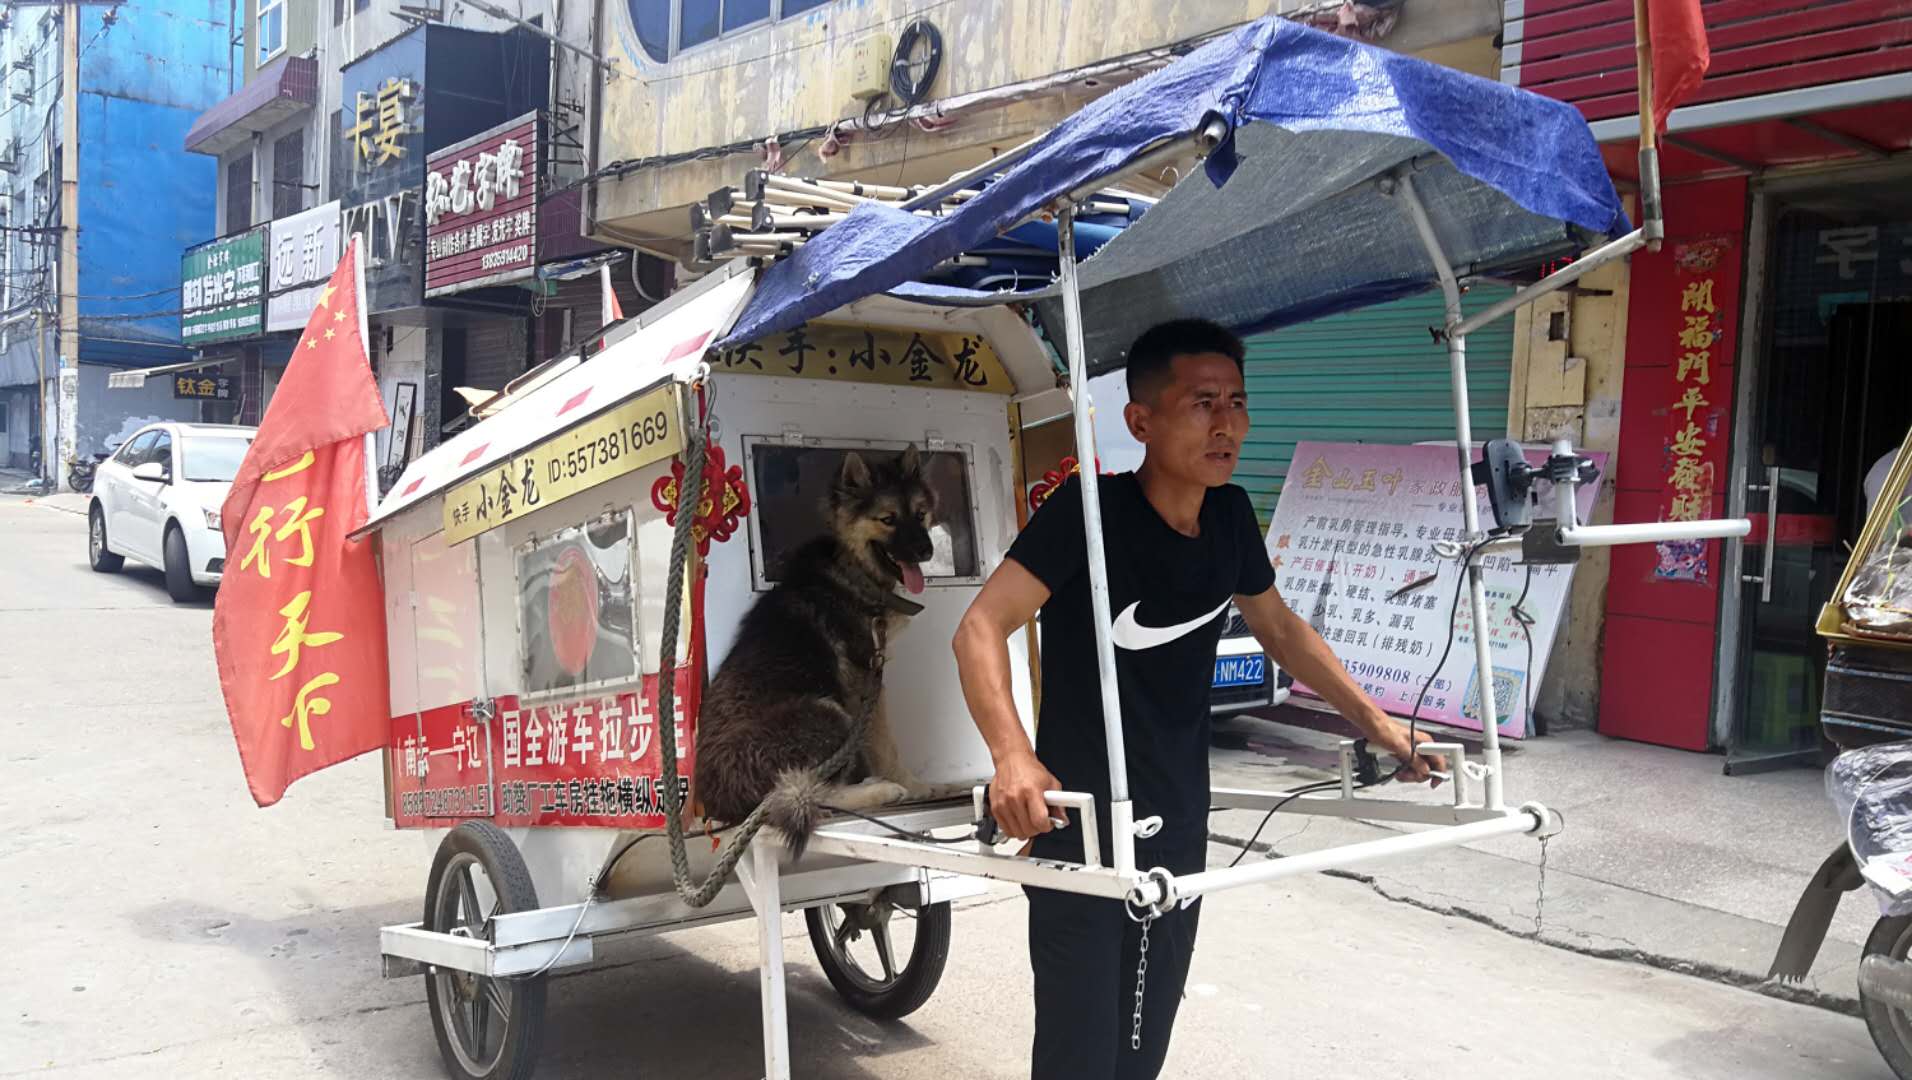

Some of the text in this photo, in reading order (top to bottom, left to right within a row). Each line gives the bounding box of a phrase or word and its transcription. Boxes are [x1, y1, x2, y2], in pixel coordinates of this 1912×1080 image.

[342, 192, 411, 265] KTV
[548, 411, 668, 484] ID:557381669
[1214, 659, 1263, 682] NM422
